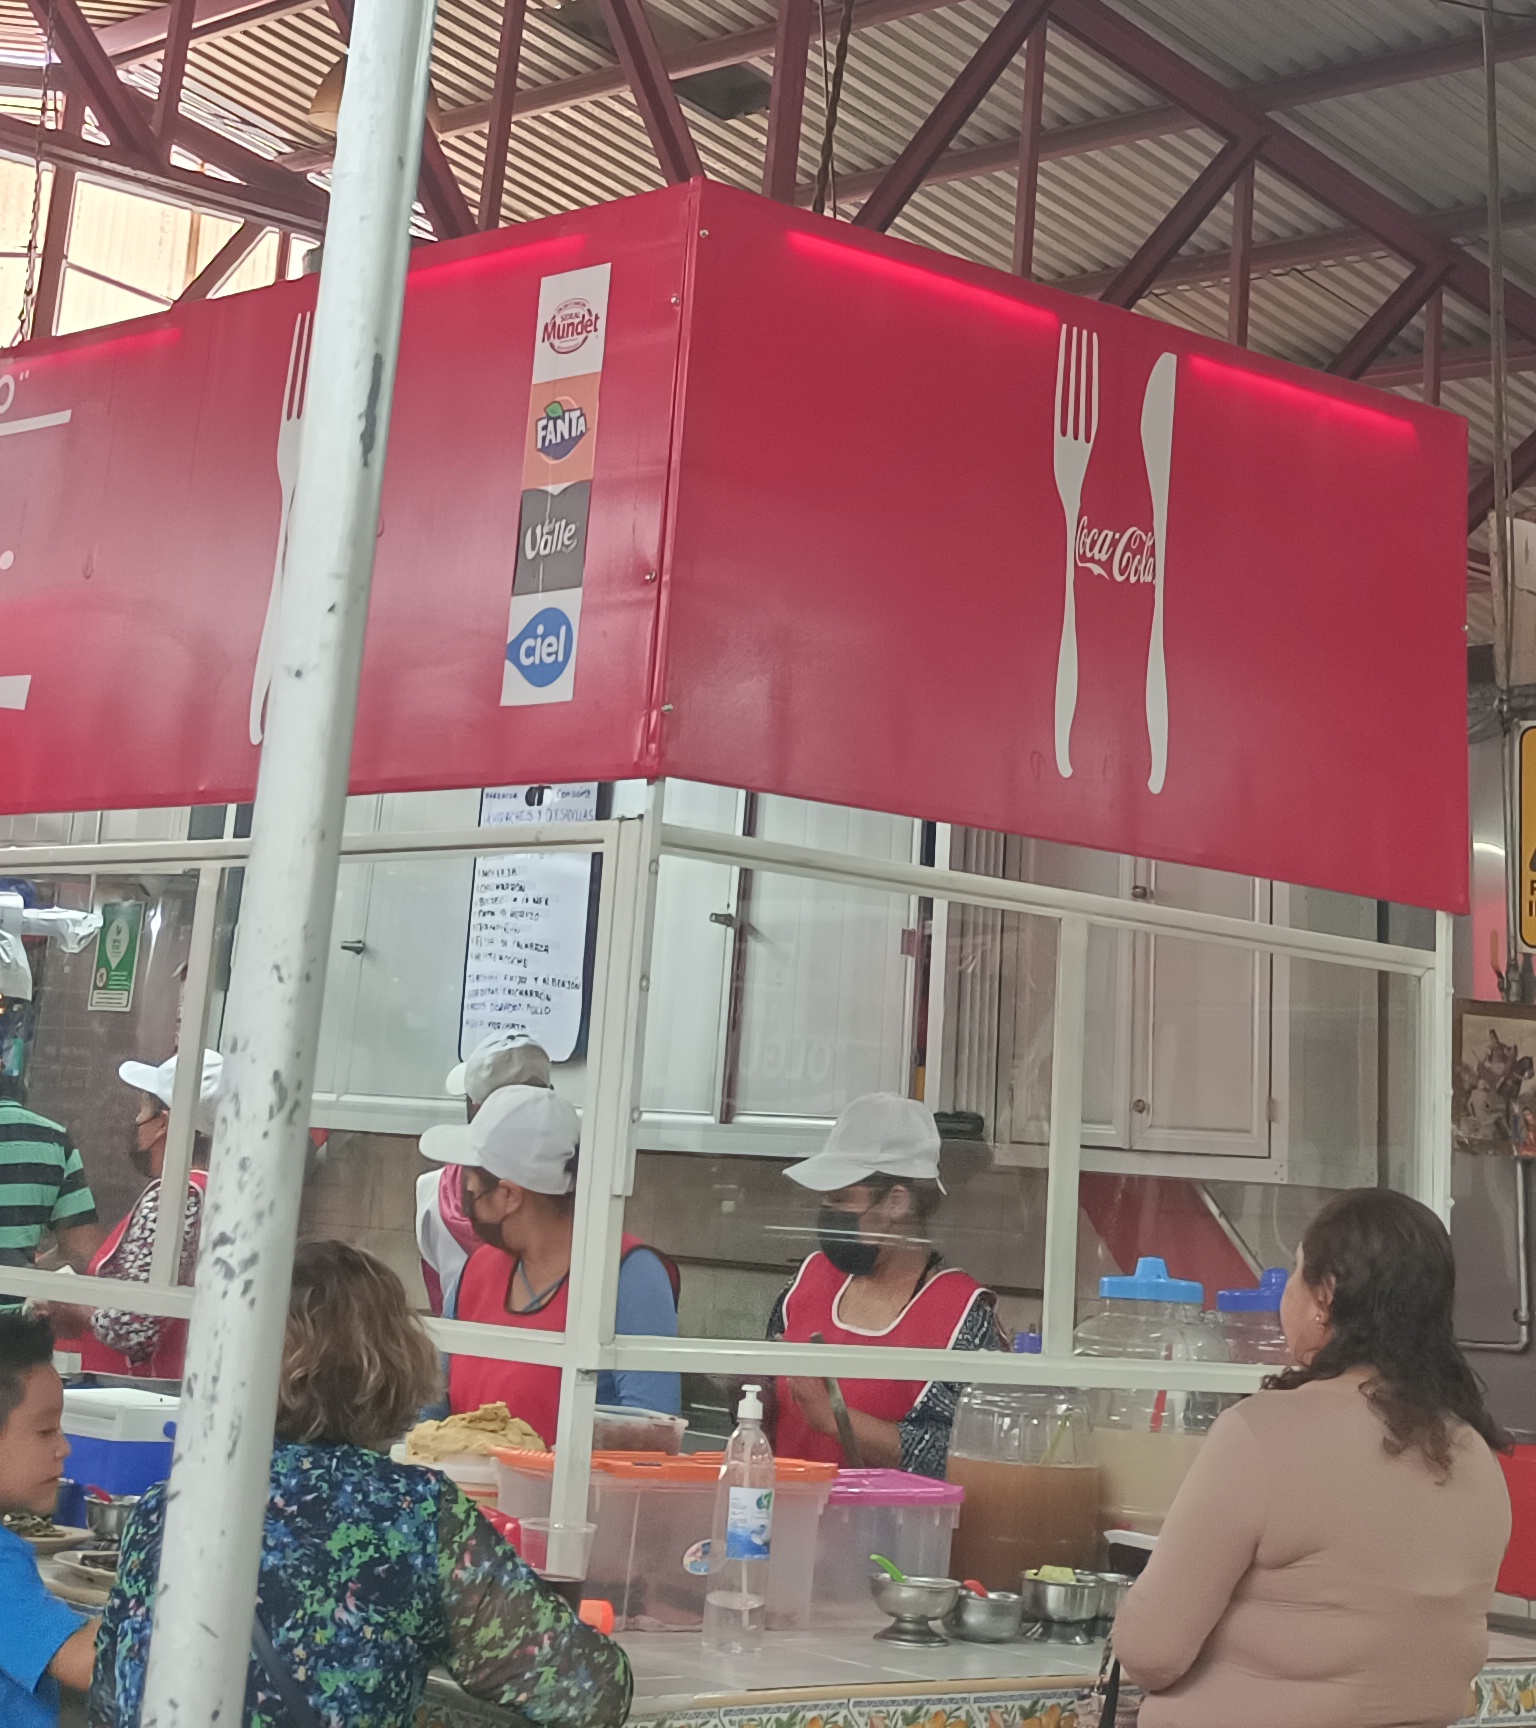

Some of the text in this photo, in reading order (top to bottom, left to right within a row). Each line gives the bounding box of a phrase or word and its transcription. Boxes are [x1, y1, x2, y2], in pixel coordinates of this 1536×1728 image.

[541, 312, 601, 344] Mundet
[536, 410, 587, 450] FANTA
[524, 518, 576, 560] Valle
[1076, 515, 1156, 584] Coca-Cola
[519, 624, 566, 667] ciel
